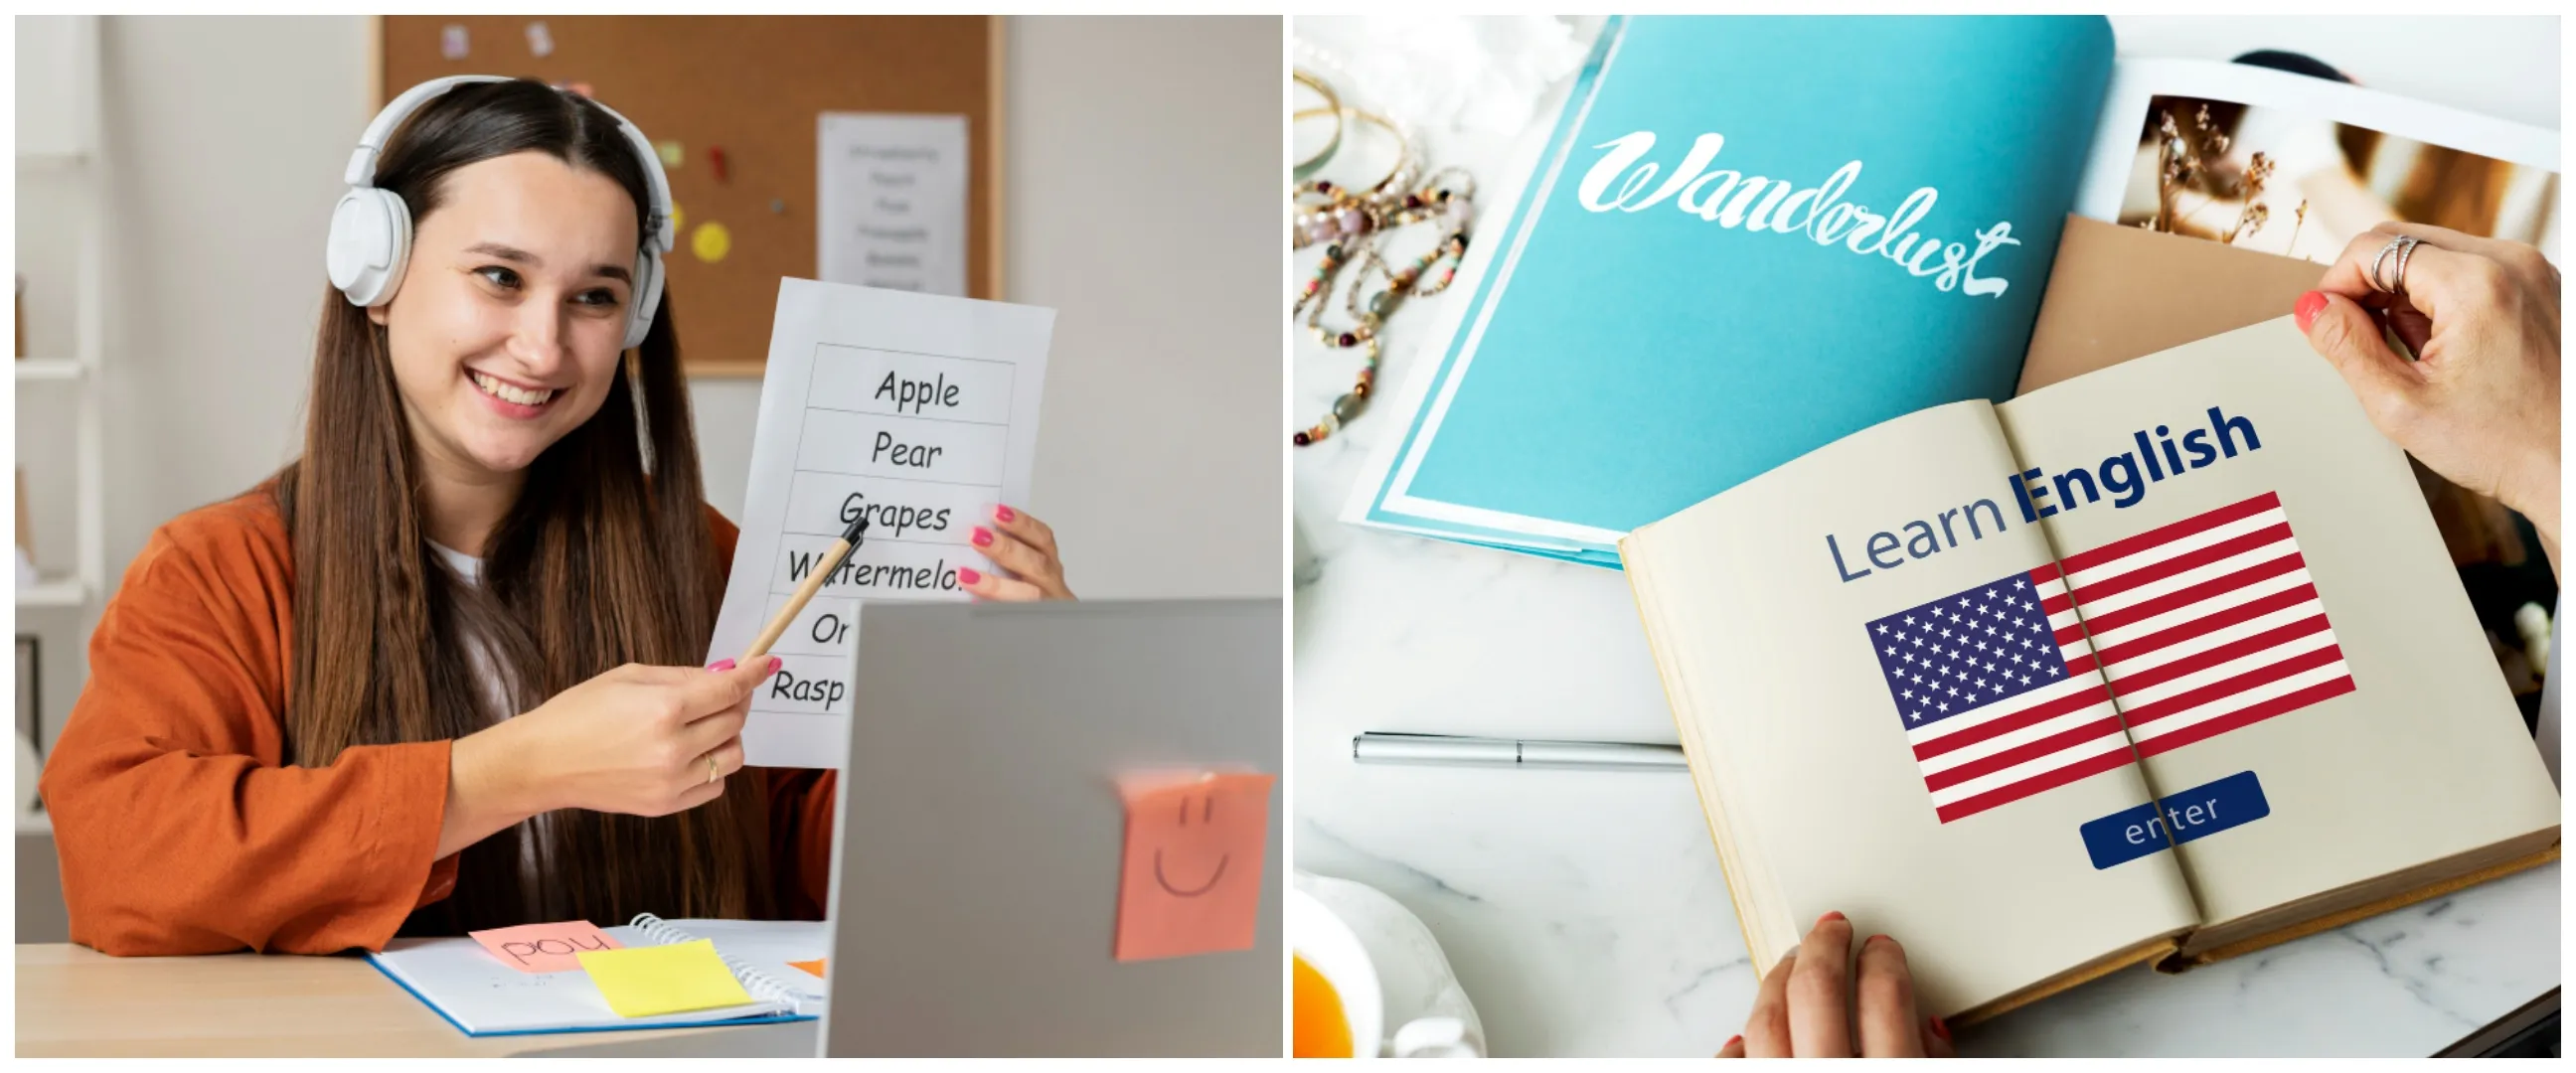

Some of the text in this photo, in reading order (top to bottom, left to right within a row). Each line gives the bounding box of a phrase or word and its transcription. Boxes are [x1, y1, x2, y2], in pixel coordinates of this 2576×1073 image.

[1578, 130, 2021, 298] Wanderlust
[875, 370, 960, 414] Apple
[872, 430, 942, 469] Pear
[840, 491, 951, 537] Grapes
[1826, 405, 2262, 583] Learn English
[788, 549, 962, 591] Wtermelo
[2125, 798, 2217, 844] enter
